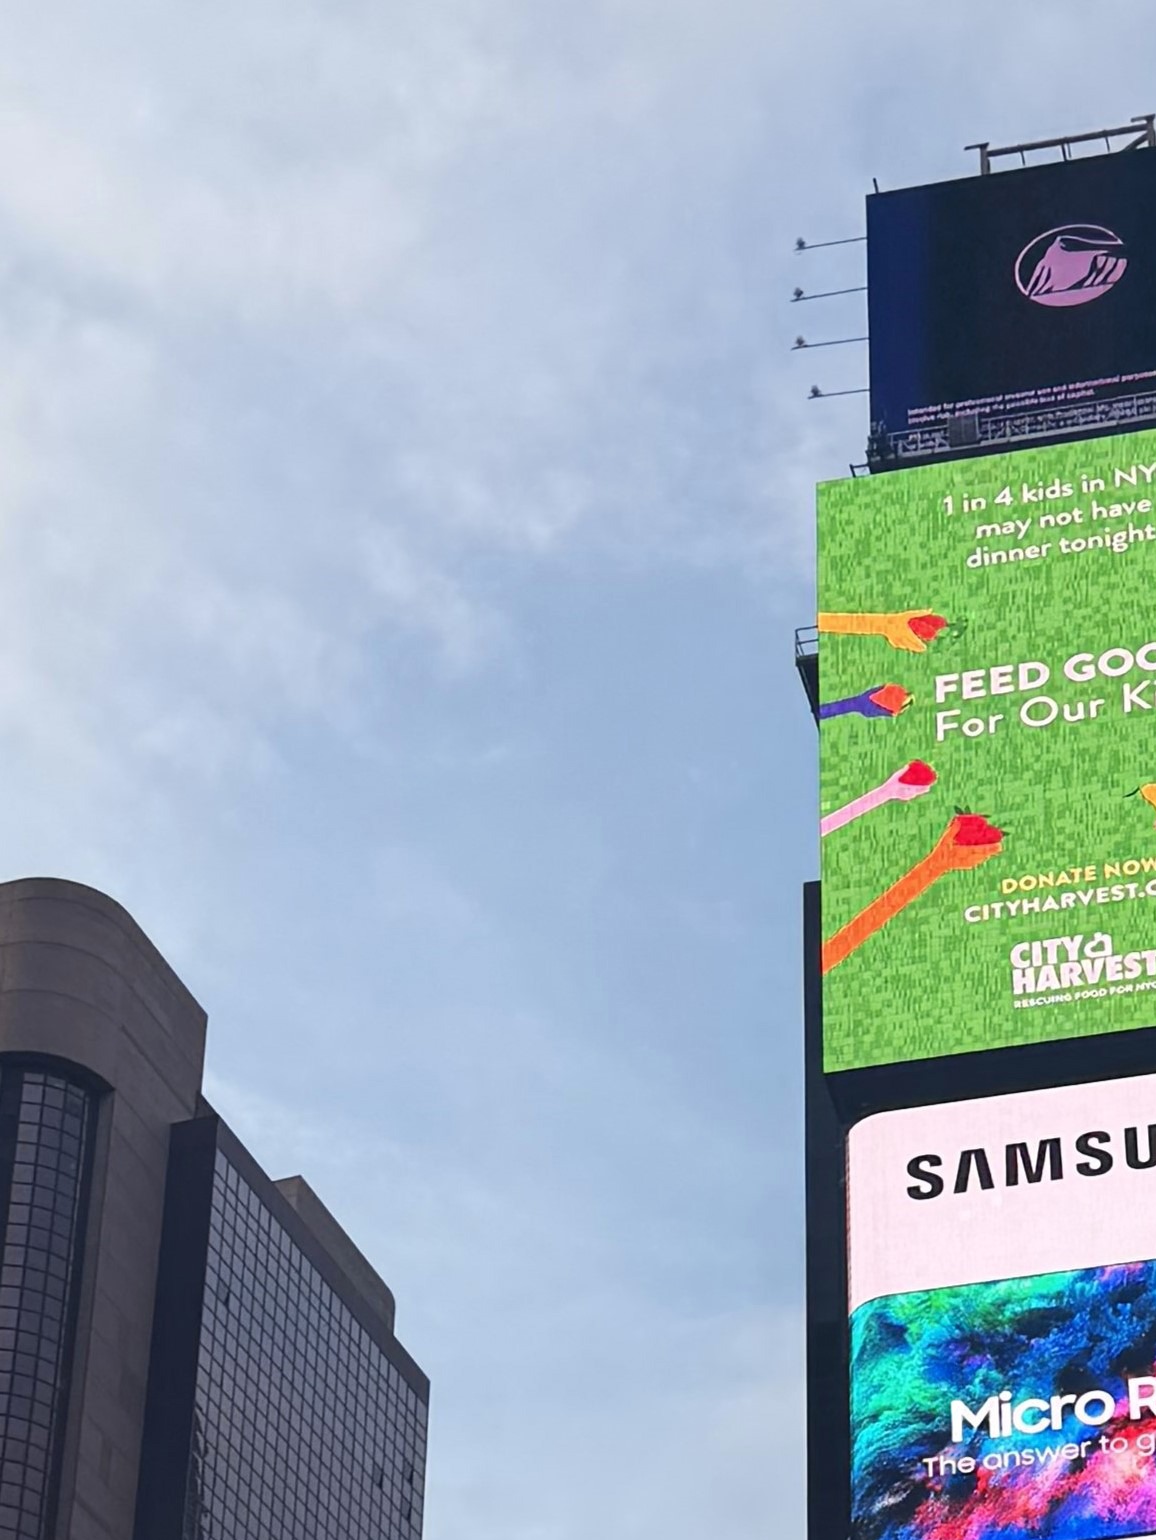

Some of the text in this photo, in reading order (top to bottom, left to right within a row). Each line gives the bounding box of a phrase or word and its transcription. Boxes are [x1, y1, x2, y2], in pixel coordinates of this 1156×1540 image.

[943, 494, 954, 516] 1
[963, 493, 986, 513] in
[994, 486, 1014, 506] 4
[1022, 478, 1074, 504] kids
[1081, 474, 1105, 494] in
[975, 498, 1153, 540] may not have
[966, 543, 1052, 568] dinner
[935, 662, 1051, 704] FEED
[936, 709, 1004, 742] For
[1019, 696, 1105, 728] Our
[1002, 865, 1097, 895] DONATE
[1010, 934, 1084, 969] CITY
[1013, 992, 1072, 1009] RESCUING
[1074, 987, 1107, 1001] FOOD
[1109, 983, 1134, 996] FOR
[951, 1389, 1116, 1443] Micro
[922, 1456, 976, 1479] The
[982, 1439, 1092, 1471] answer
[1099, 1433, 1128, 1454] to
